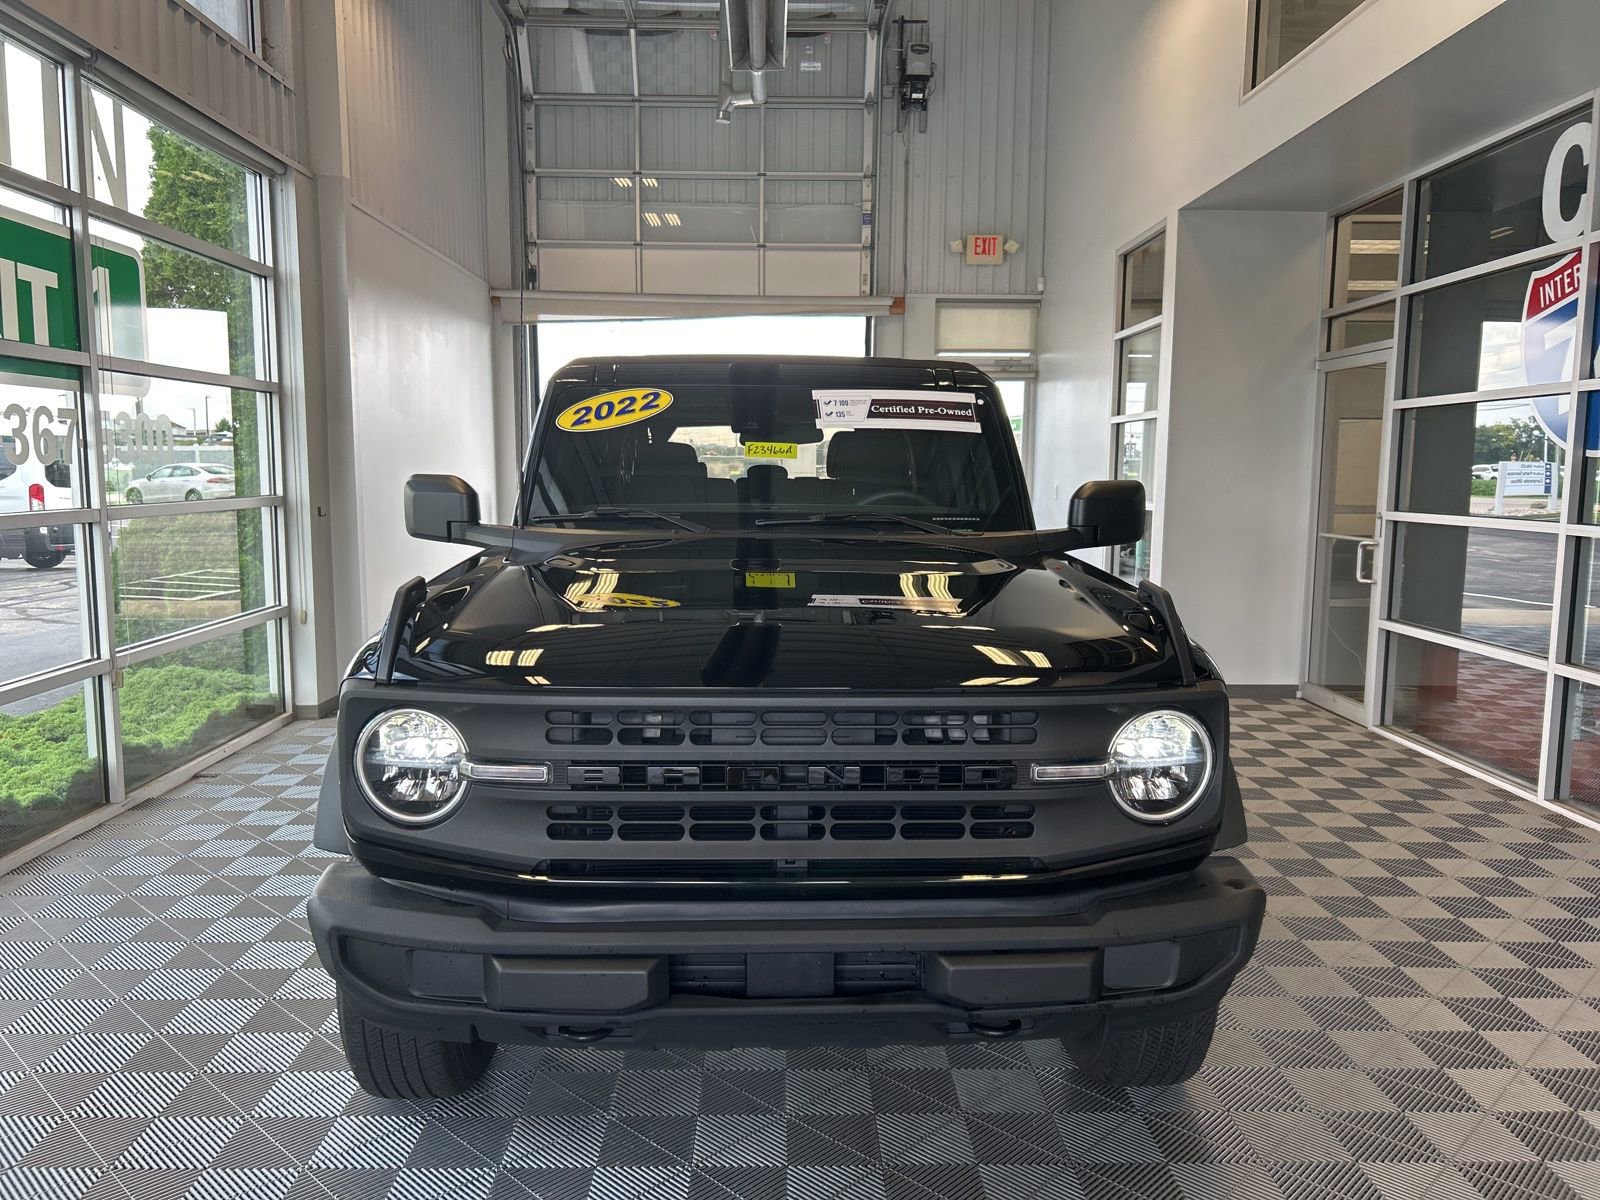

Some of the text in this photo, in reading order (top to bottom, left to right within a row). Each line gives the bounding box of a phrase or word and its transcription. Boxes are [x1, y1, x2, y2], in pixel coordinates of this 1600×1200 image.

[973, 236, 998, 256] EXIT
[570, 391, 661, 427] 2022
[871, 404, 973, 417] Certified Pre-Owned
[567, 765, 1017, 785] BRONCO
